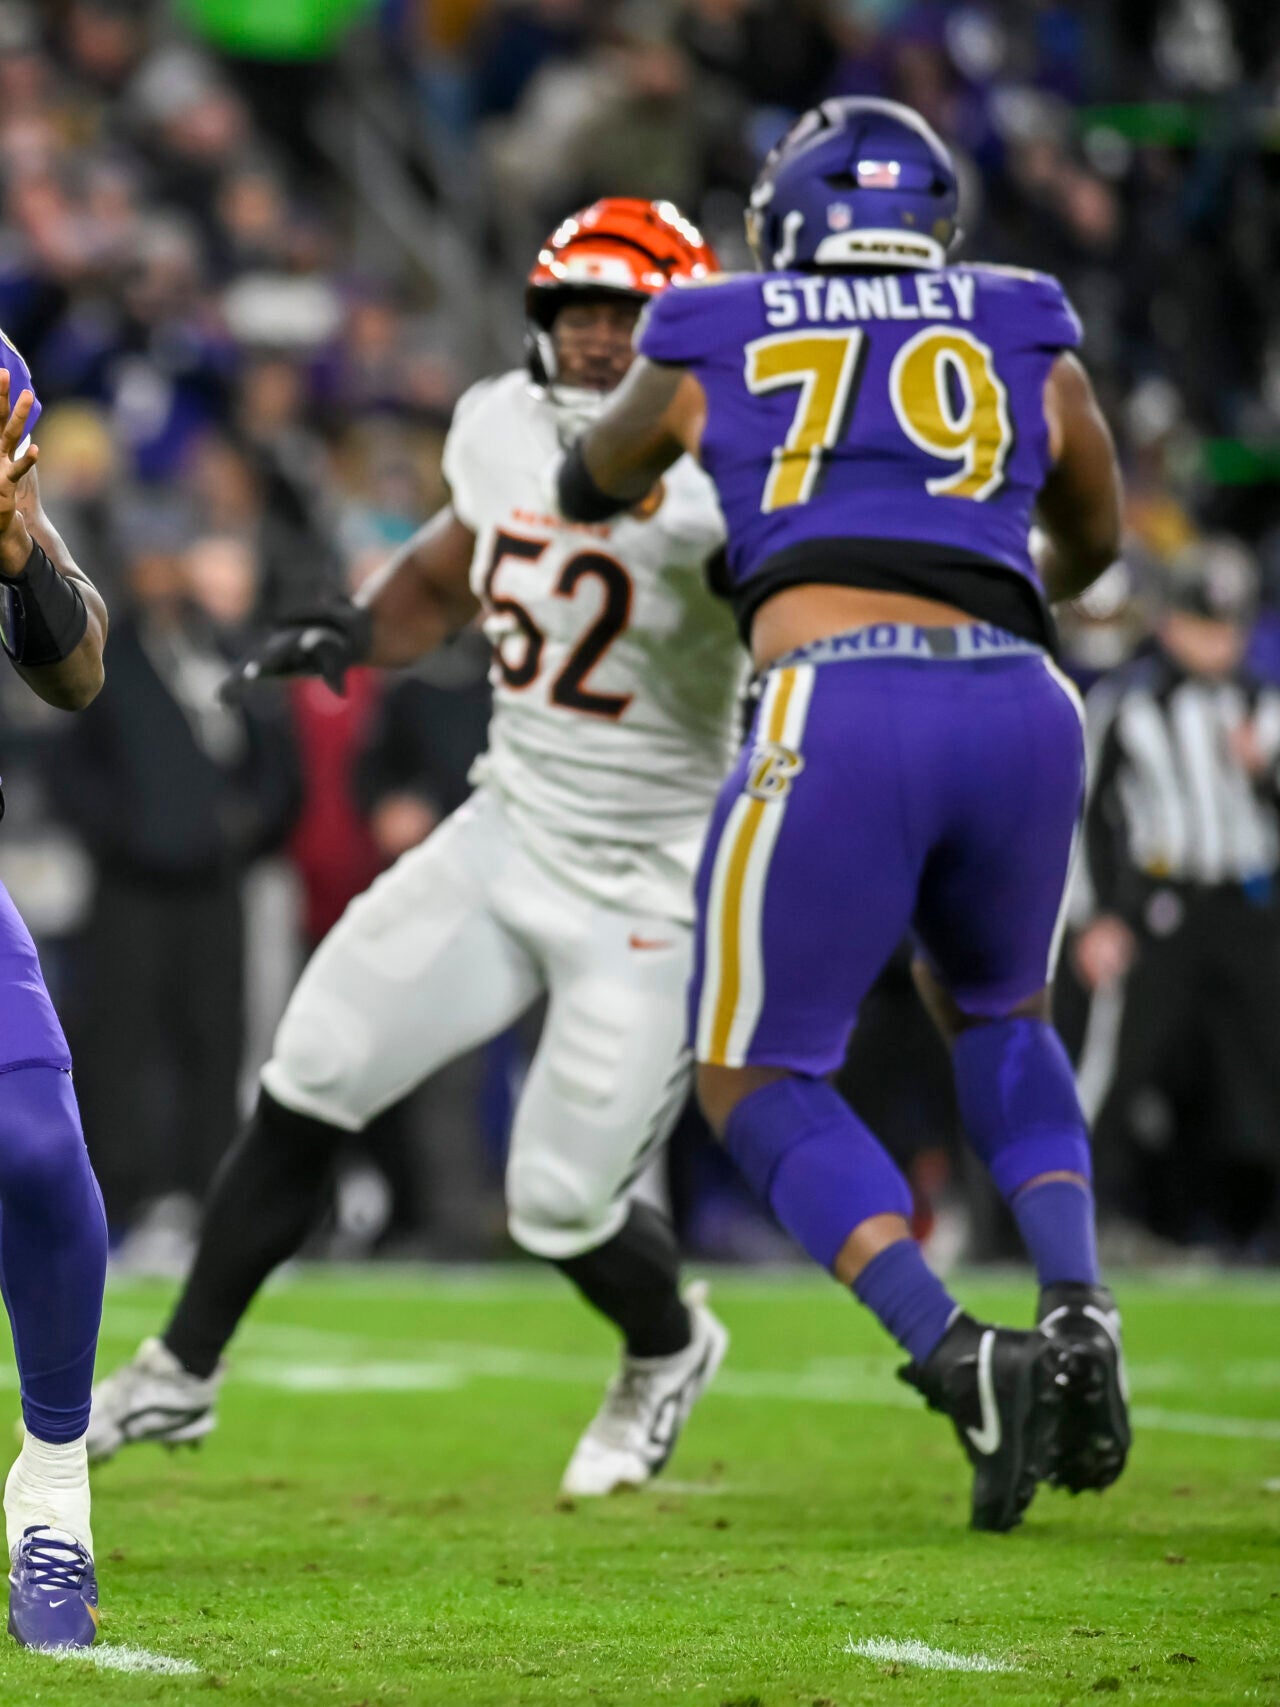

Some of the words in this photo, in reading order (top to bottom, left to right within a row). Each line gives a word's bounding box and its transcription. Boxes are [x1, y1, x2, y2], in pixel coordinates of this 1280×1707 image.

[762, 273, 976, 327] STANLEY
[744, 325, 1013, 514] 79
[484, 525, 636, 721] 52
